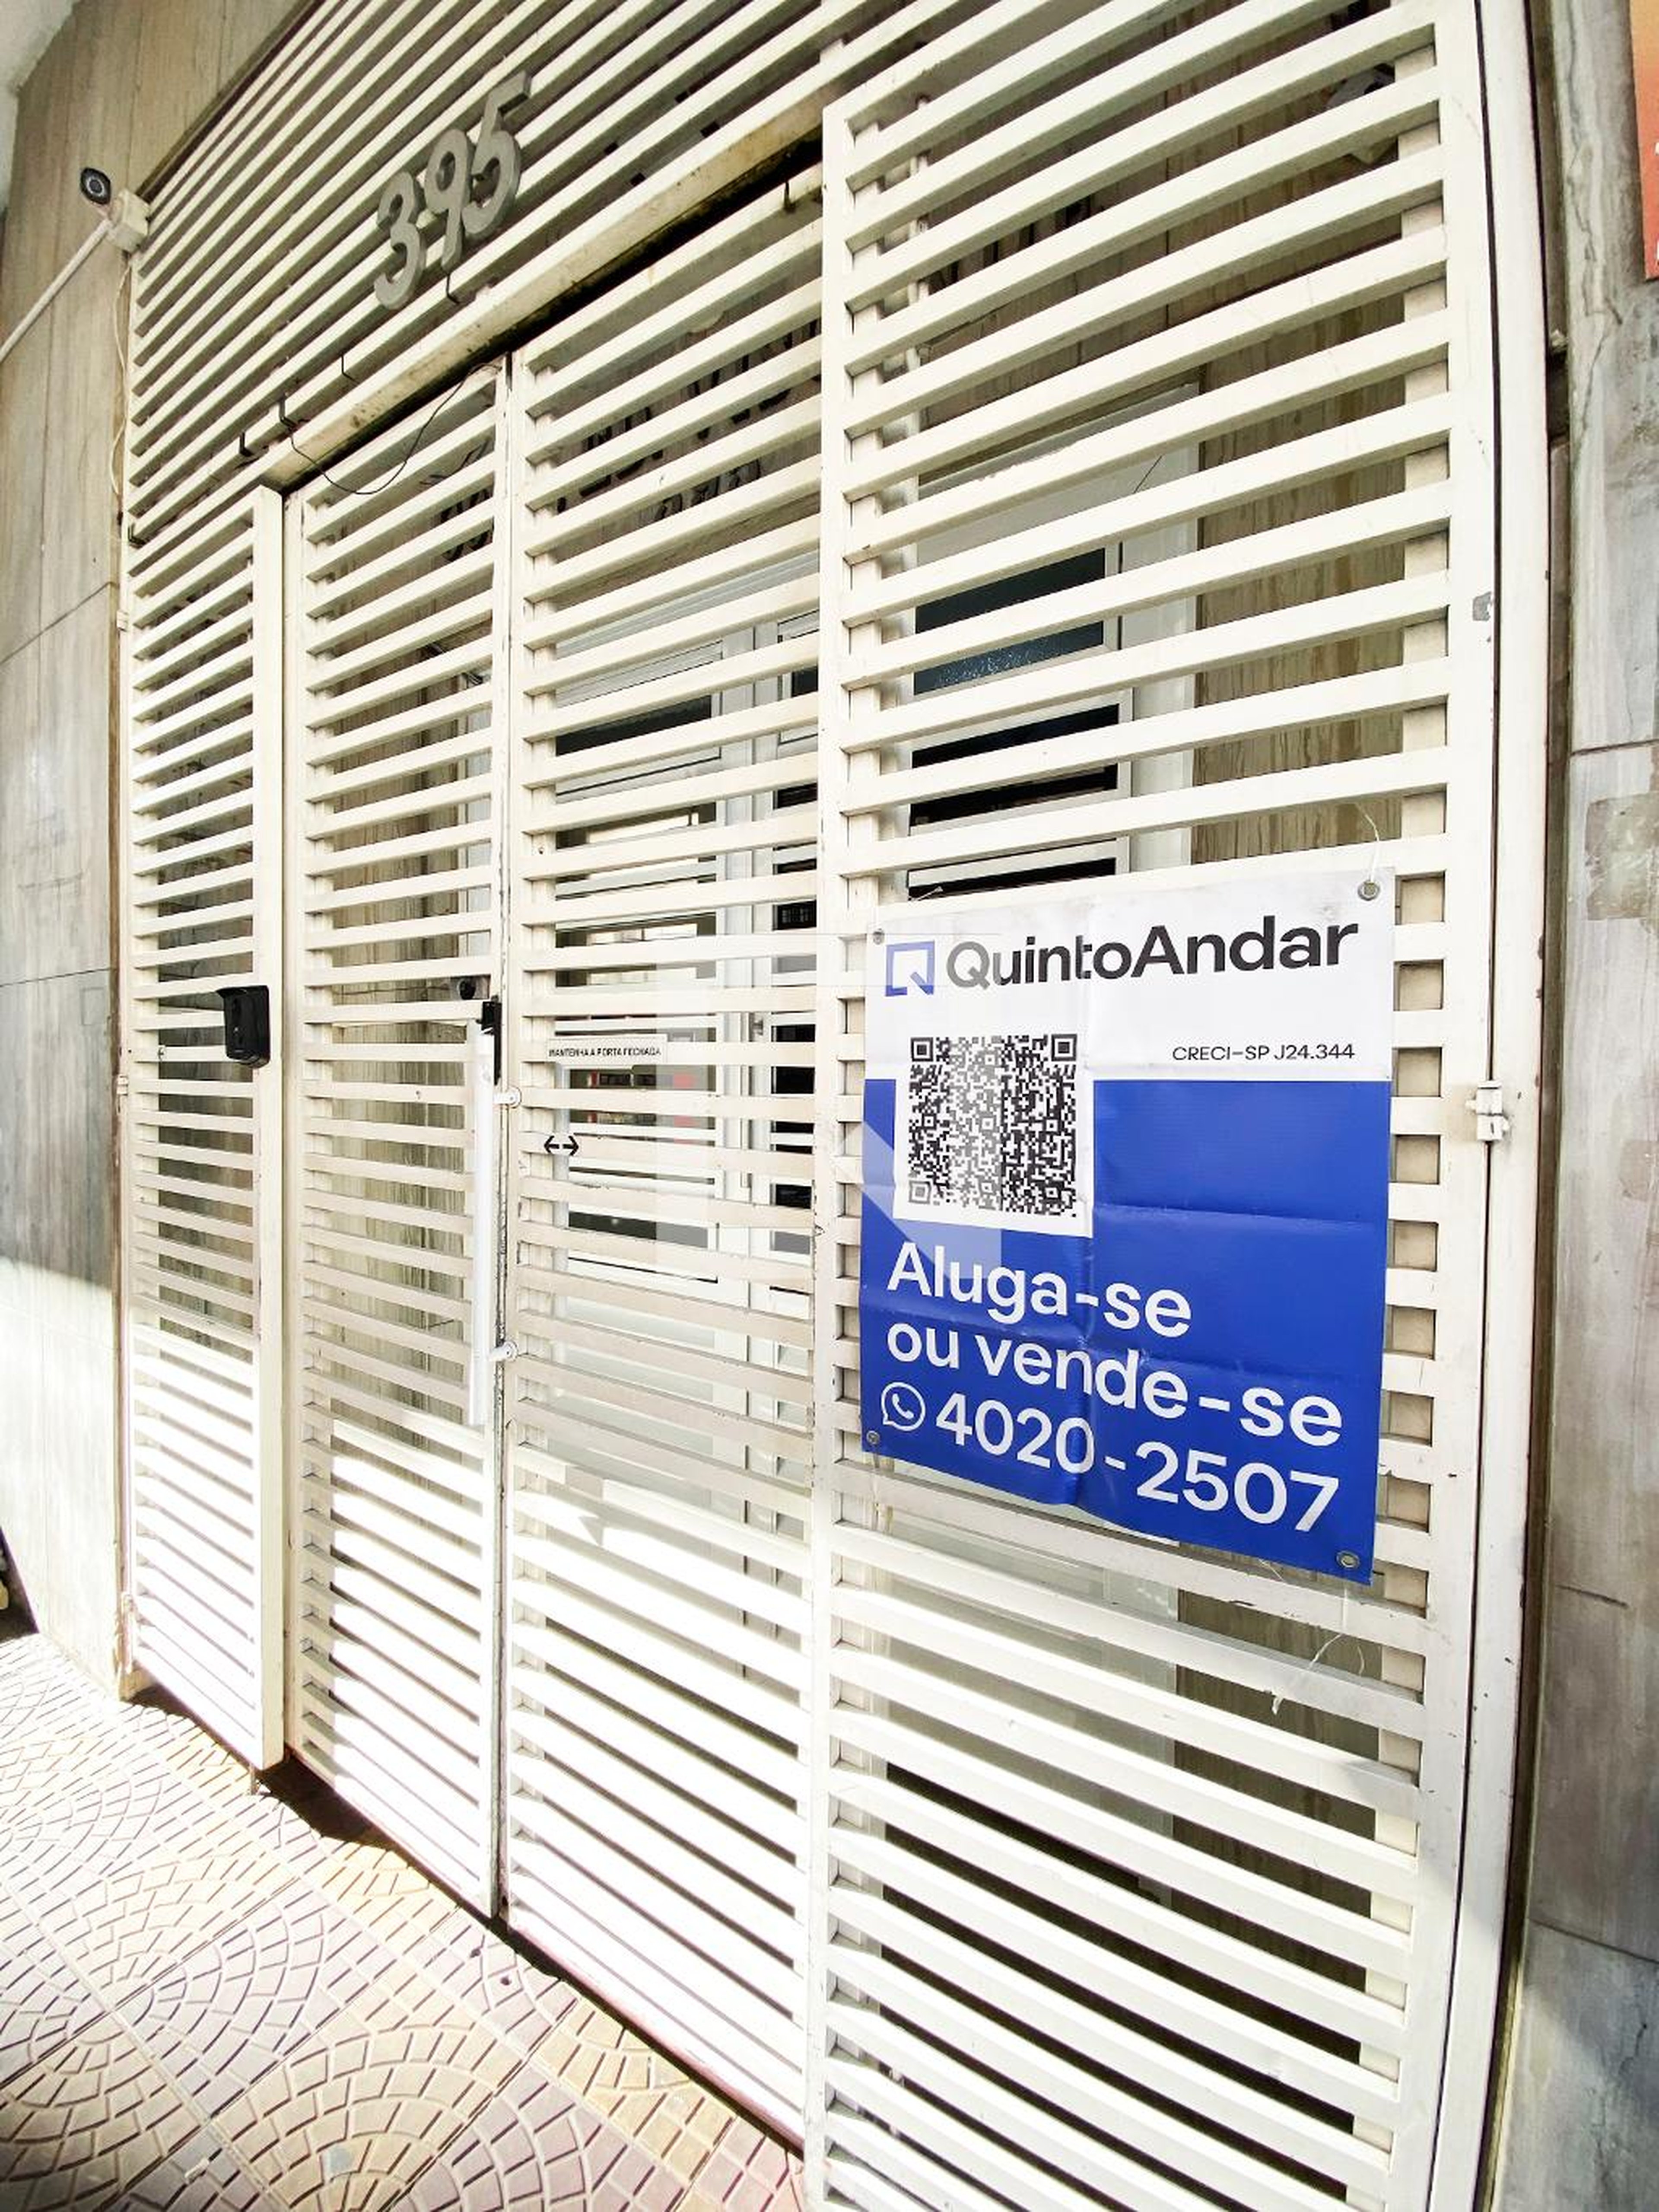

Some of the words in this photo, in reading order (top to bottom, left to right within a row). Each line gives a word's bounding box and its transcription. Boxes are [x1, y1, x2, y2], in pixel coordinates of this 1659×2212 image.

[374, 70, 532, 310] 395
[947, 915, 1359, 990] QuintoAndar
[1173, 1045, 1270, 1060] CRECI-SP
[1274, 1044, 1355, 1060] J24.344
[887, 1241, 1192, 1337] Aluga-se
[887, 1323, 959, 1369] ou
[975, 1335, 1342, 1446] vende-se
[936, 1393, 1339, 1532] 4020-2507
